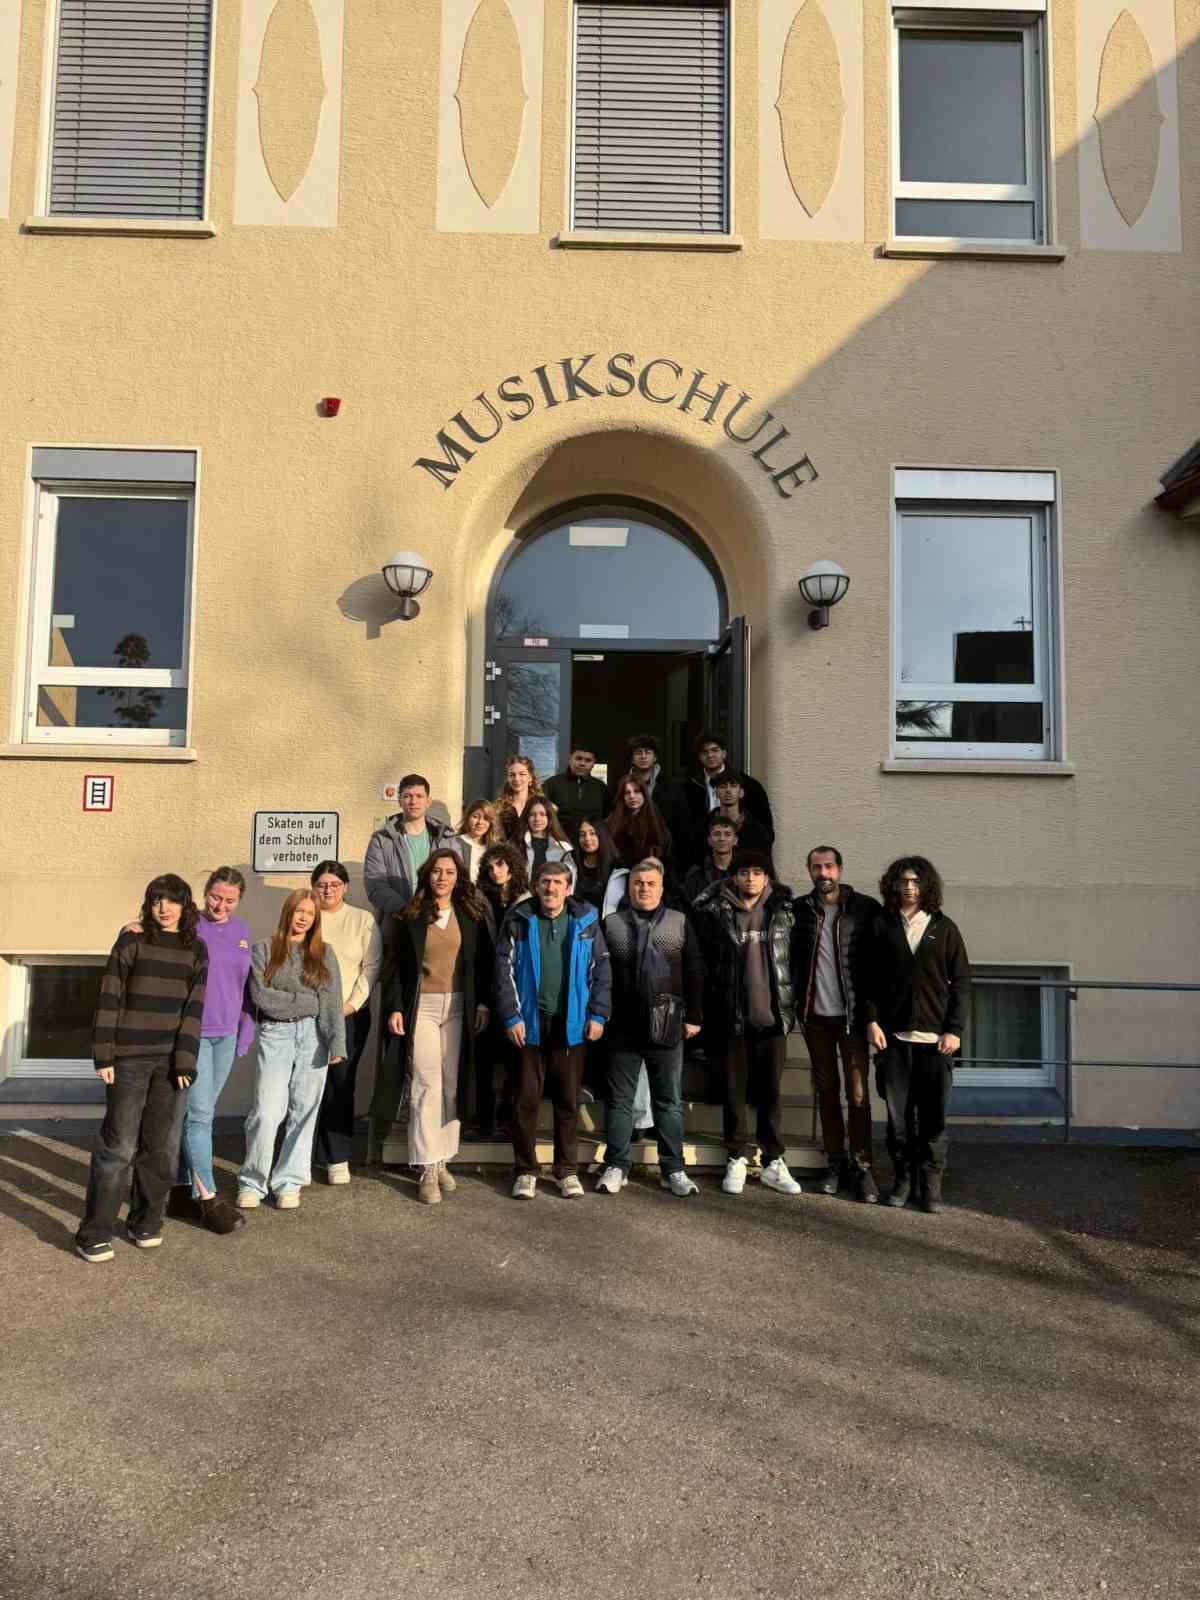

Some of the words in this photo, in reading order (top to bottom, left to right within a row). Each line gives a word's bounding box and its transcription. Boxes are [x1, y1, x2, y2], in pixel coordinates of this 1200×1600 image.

[412, 353, 819, 499] MUSIKSCHULE
[267, 816, 303, 829] Skaten
[308, 817, 326, 829] auf
[259, 833, 281, 846] dem
[286, 833, 333, 846] Schulhof
[272, 850, 319, 862] verboten
